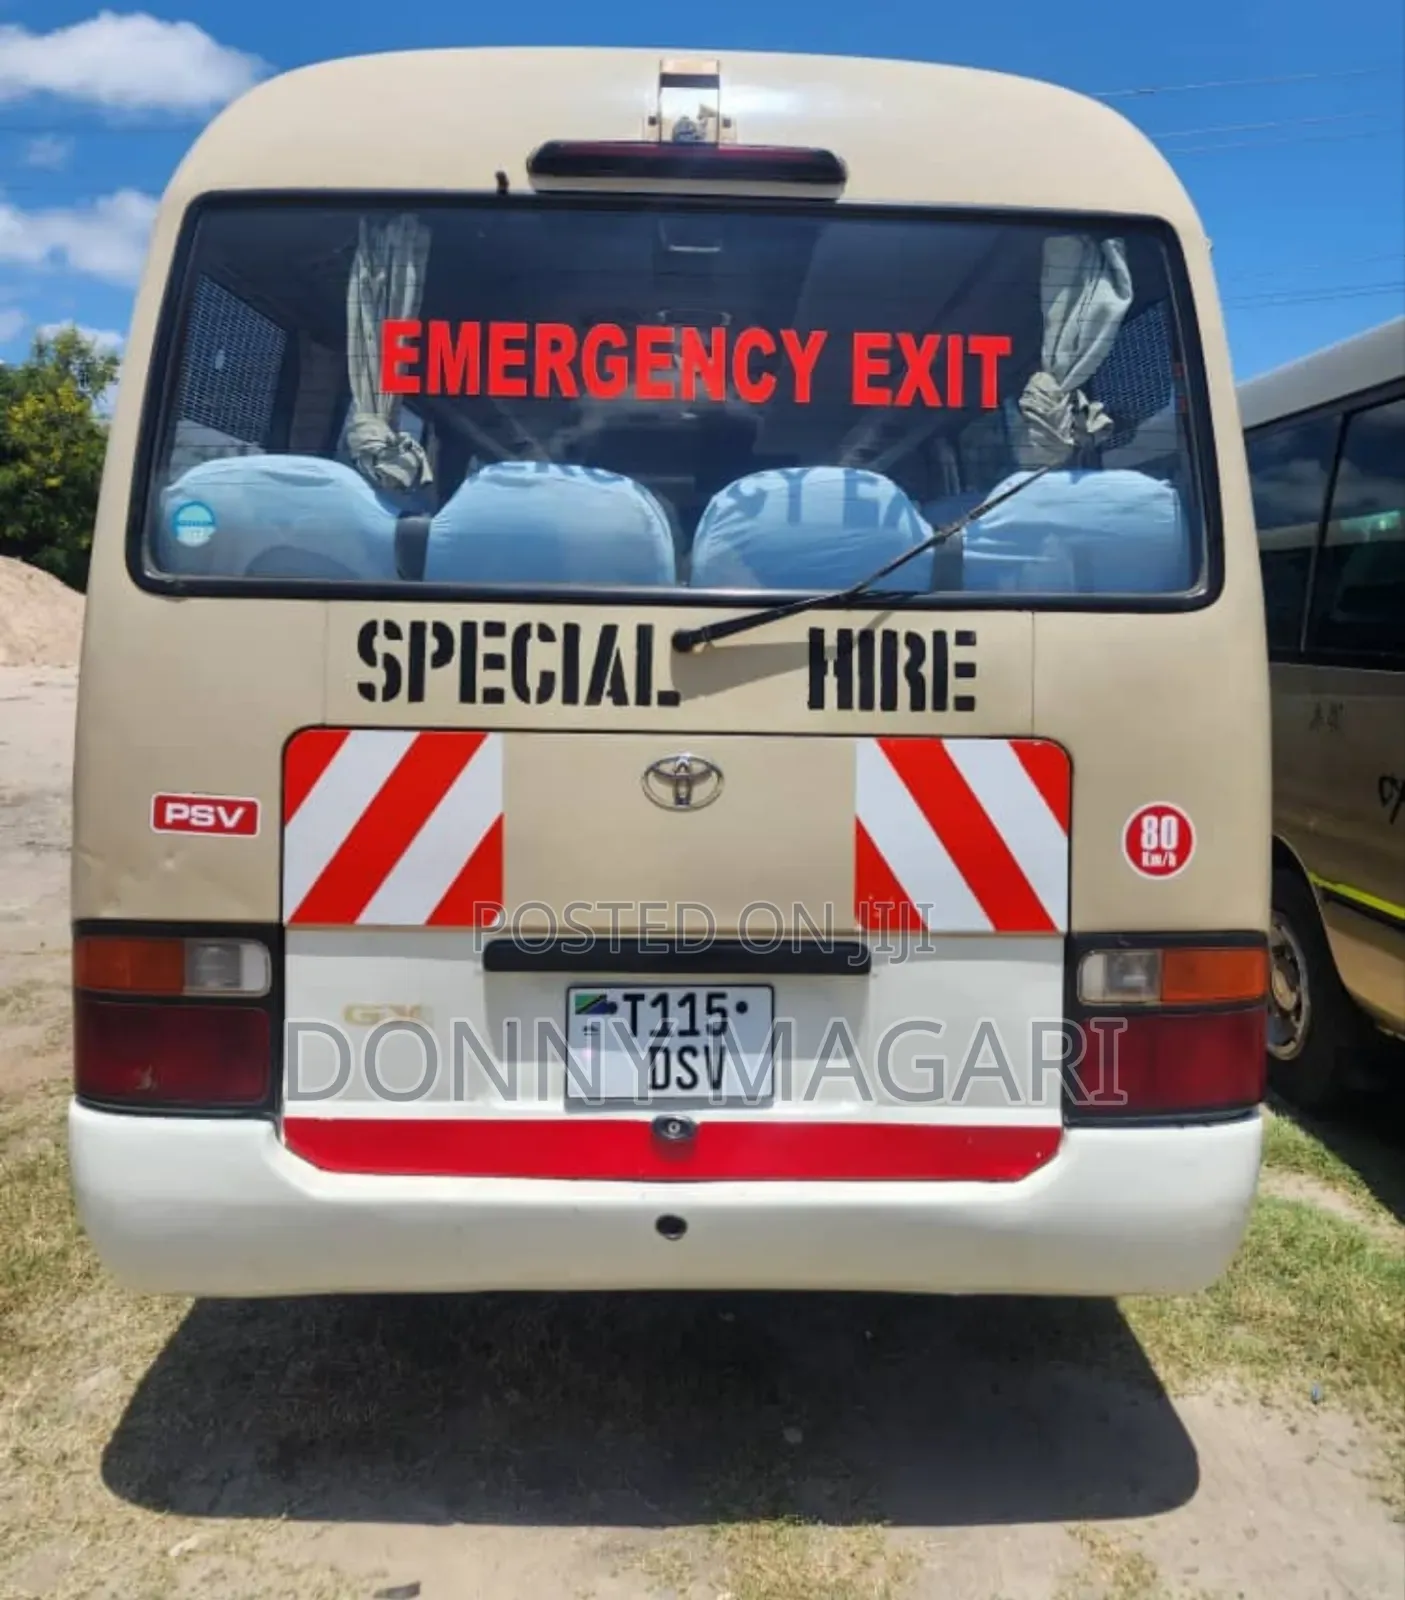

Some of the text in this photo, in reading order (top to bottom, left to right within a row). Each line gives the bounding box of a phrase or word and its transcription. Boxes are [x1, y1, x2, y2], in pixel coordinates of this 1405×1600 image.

[380, 319, 1012, 408] EMERGENCY EXIT
[357, 619, 977, 712] SPECIAL HIRE
[164, 802, 247, 828] PSV
[1141, 815, 1178, 850] 80
[1142, 851, 1177, 867] Km/h
[623, 992, 728, 1037] T115
[650, 1045, 725, 1090] DSV
